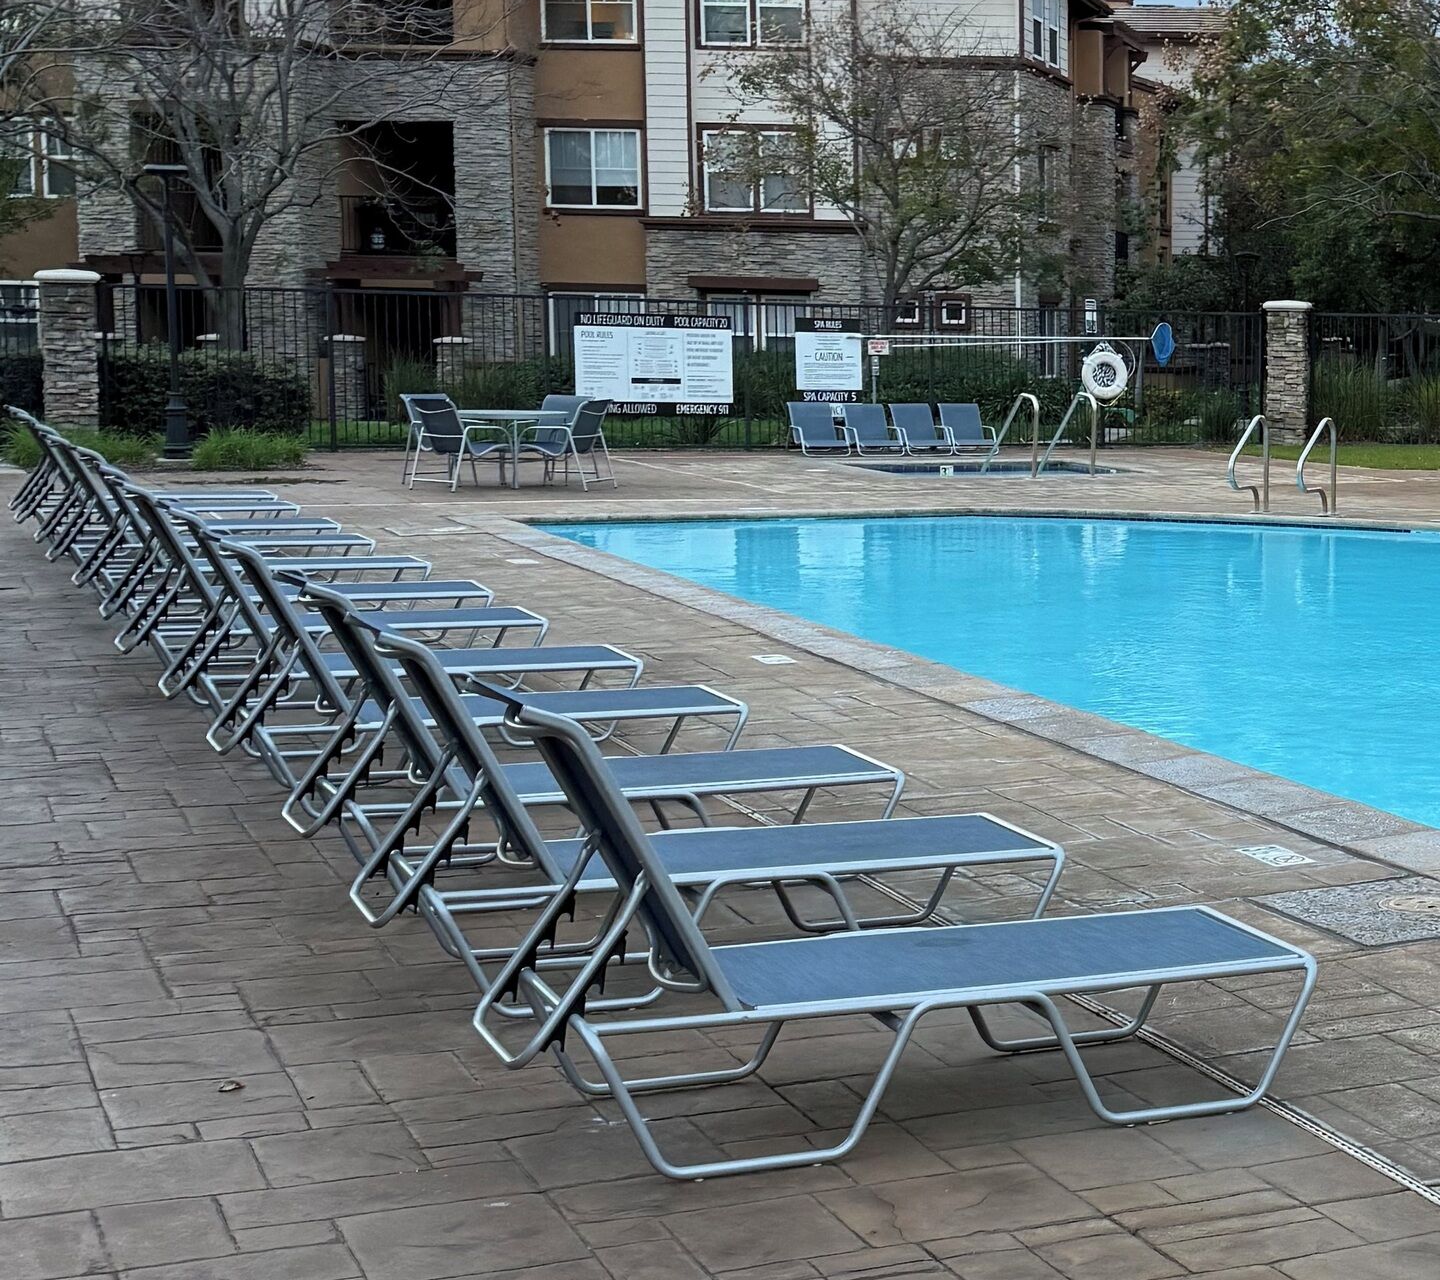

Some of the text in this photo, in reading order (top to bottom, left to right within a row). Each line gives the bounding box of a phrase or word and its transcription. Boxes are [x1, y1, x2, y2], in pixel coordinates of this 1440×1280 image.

[580, 314, 665, 327] NO LIFEGUARD ON DUTY
[673, 316, 690, 327] POOL
[690, 316, 718, 328] CAPACITY
[813, 320, 843, 329] SPA RULES
[580, 330, 614, 339] POOL RULES
[814, 351, 844, 362] CAUTION
[803, 391, 857, 402] SPA CAPACITY 5
[622, 403, 658, 414] ALLOWED
[675, 403, 729, 415] EMERGENCY 911
